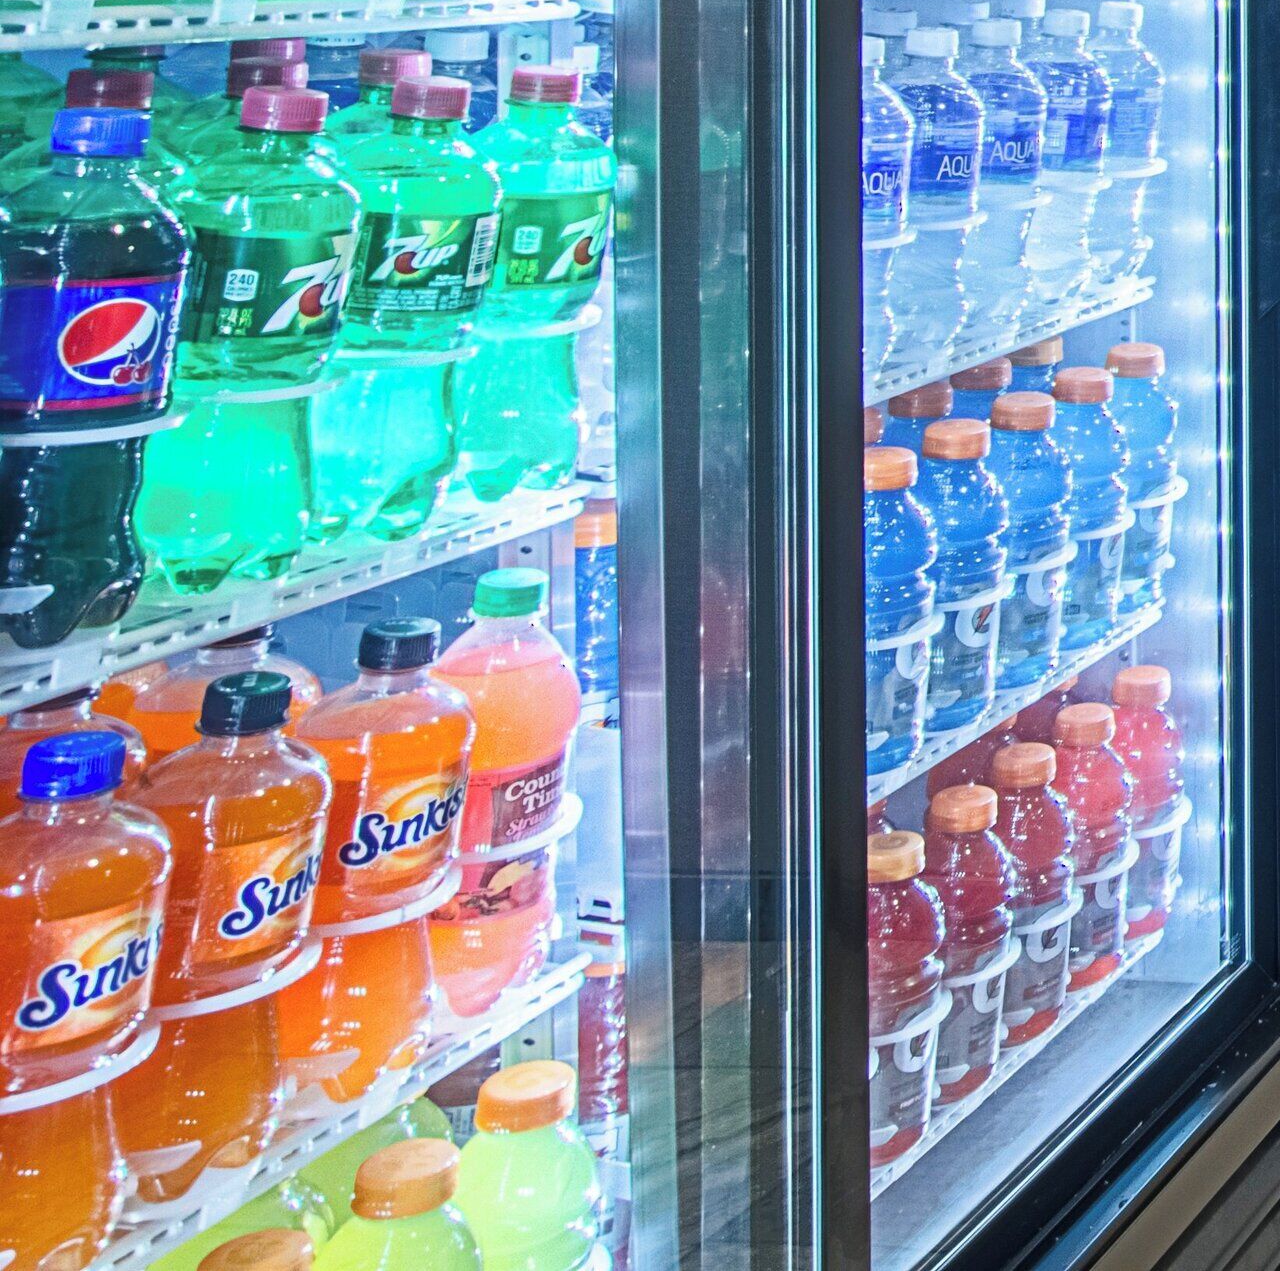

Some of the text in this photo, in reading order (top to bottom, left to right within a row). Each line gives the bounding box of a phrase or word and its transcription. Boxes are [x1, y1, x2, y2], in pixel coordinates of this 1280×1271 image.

[228, 273, 256, 286] 240
[369, 234, 461, 282] 7UP
[339, 787, 468, 867] Sunkis
